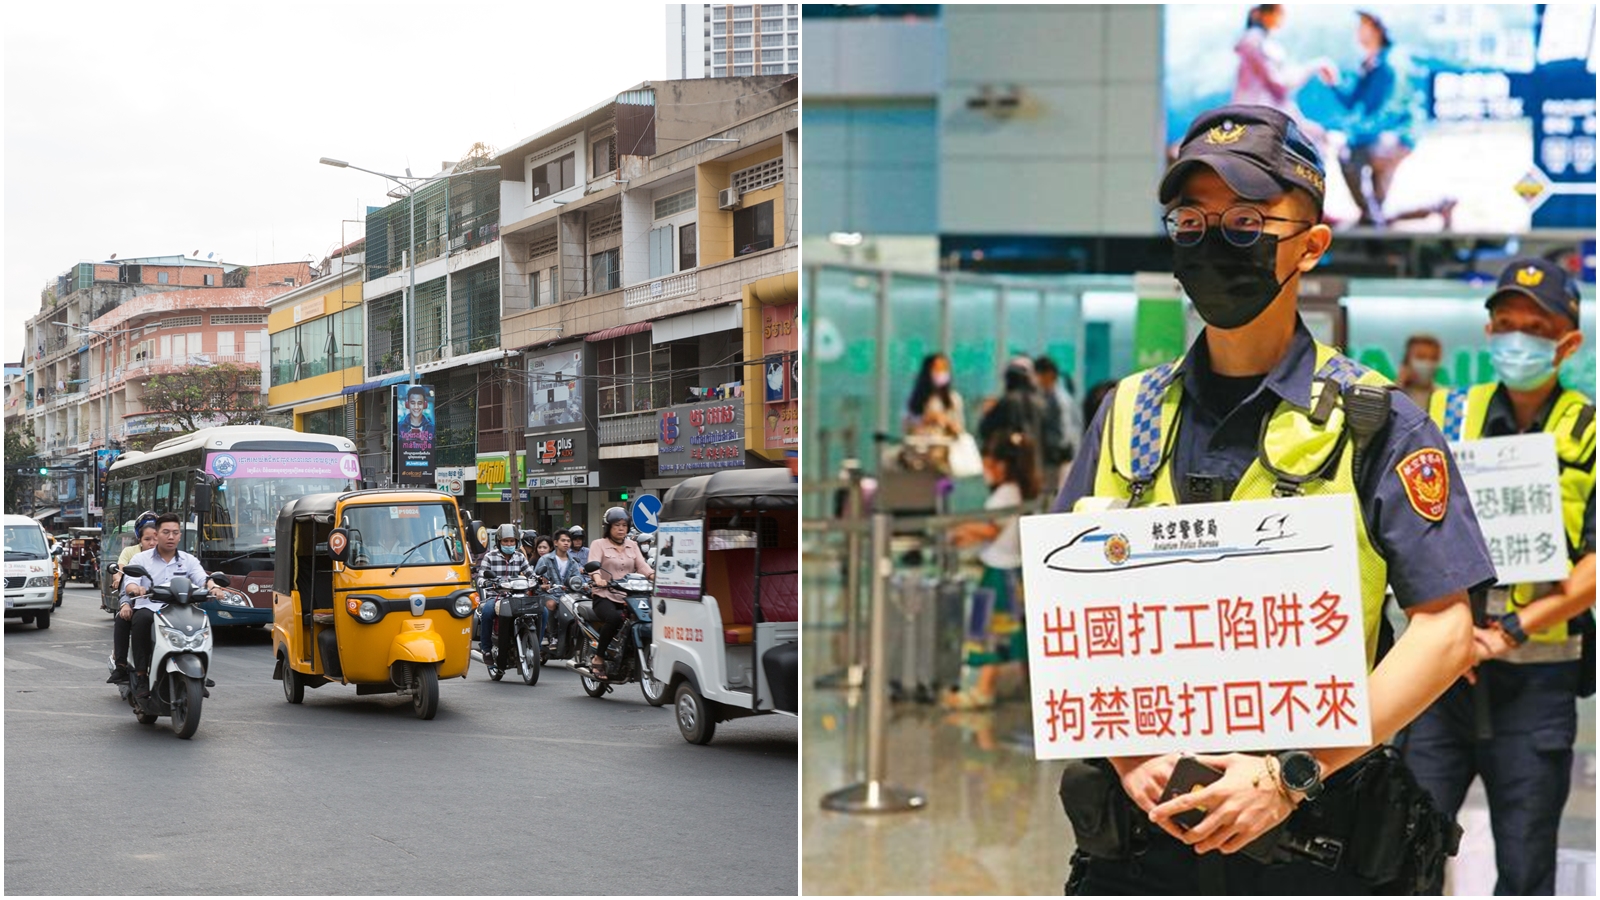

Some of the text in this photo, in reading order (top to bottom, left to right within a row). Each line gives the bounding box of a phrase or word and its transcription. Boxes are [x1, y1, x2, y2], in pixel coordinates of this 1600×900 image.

[344, 460, 358, 472] 4A
[1152, 519, 1217, 539] 航空警察局
[1043, 590, 1349, 659] 出國打工陷阱多
[1045, 675, 1358, 742] 拘禁毆打回不來
